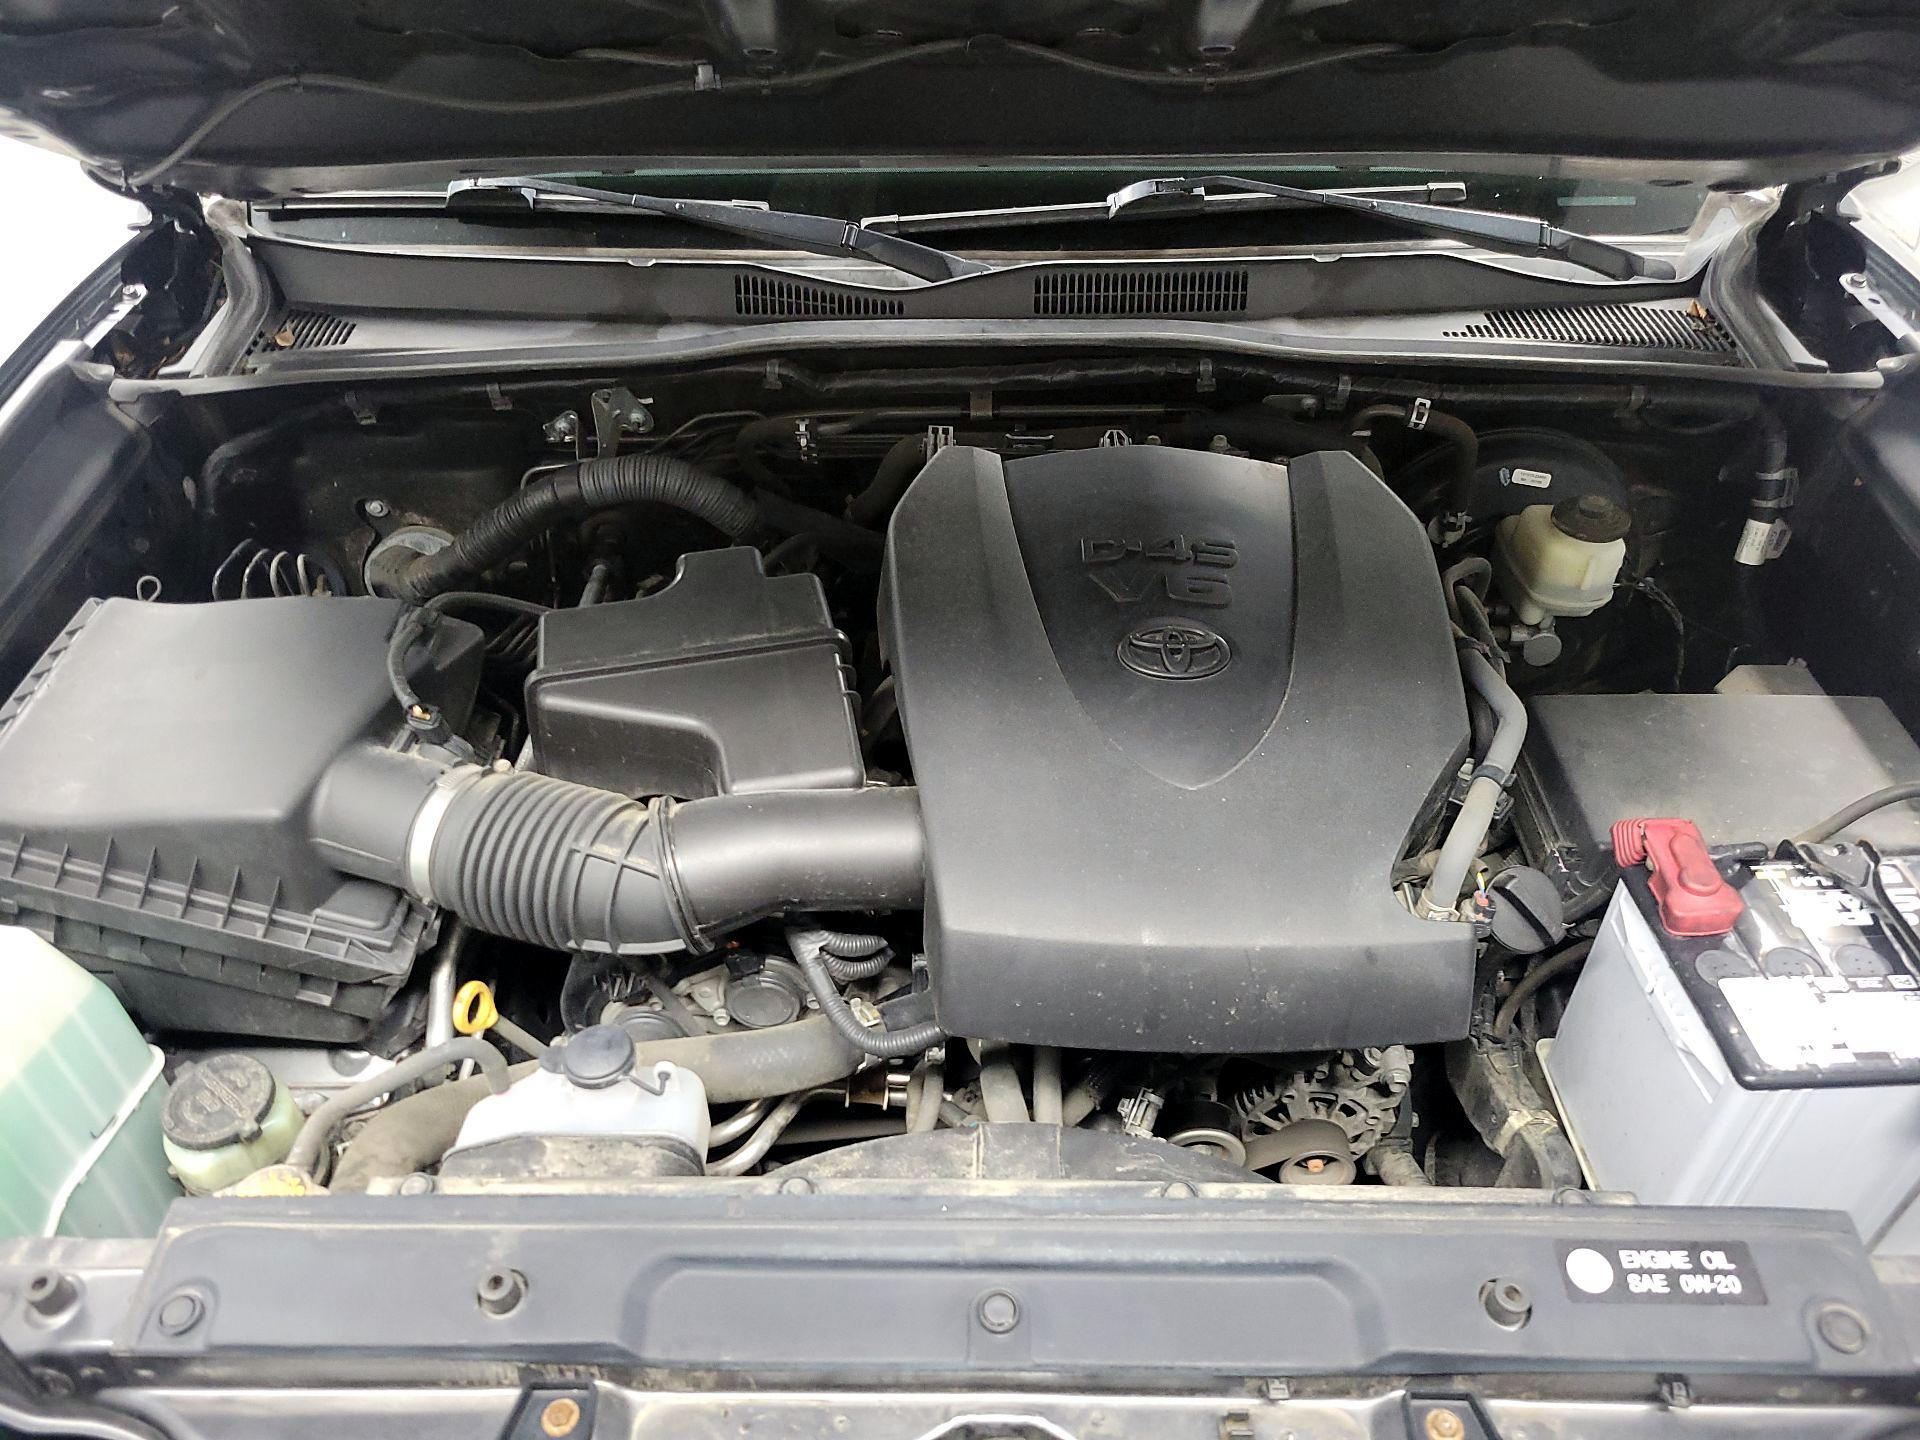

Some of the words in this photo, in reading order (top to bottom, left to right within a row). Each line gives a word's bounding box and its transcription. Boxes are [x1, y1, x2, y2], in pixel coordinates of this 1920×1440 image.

[1081, 534, 1240, 569] D-4S
[1088, 573, 1233, 609] V6
[1618, 1249, 1693, 1270] ENGINE
[1699, 1250, 1737, 1270] OIL
[1626, 1273, 1671, 1294] SAE
[1679, 1274, 1743, 1294] 0W-20
